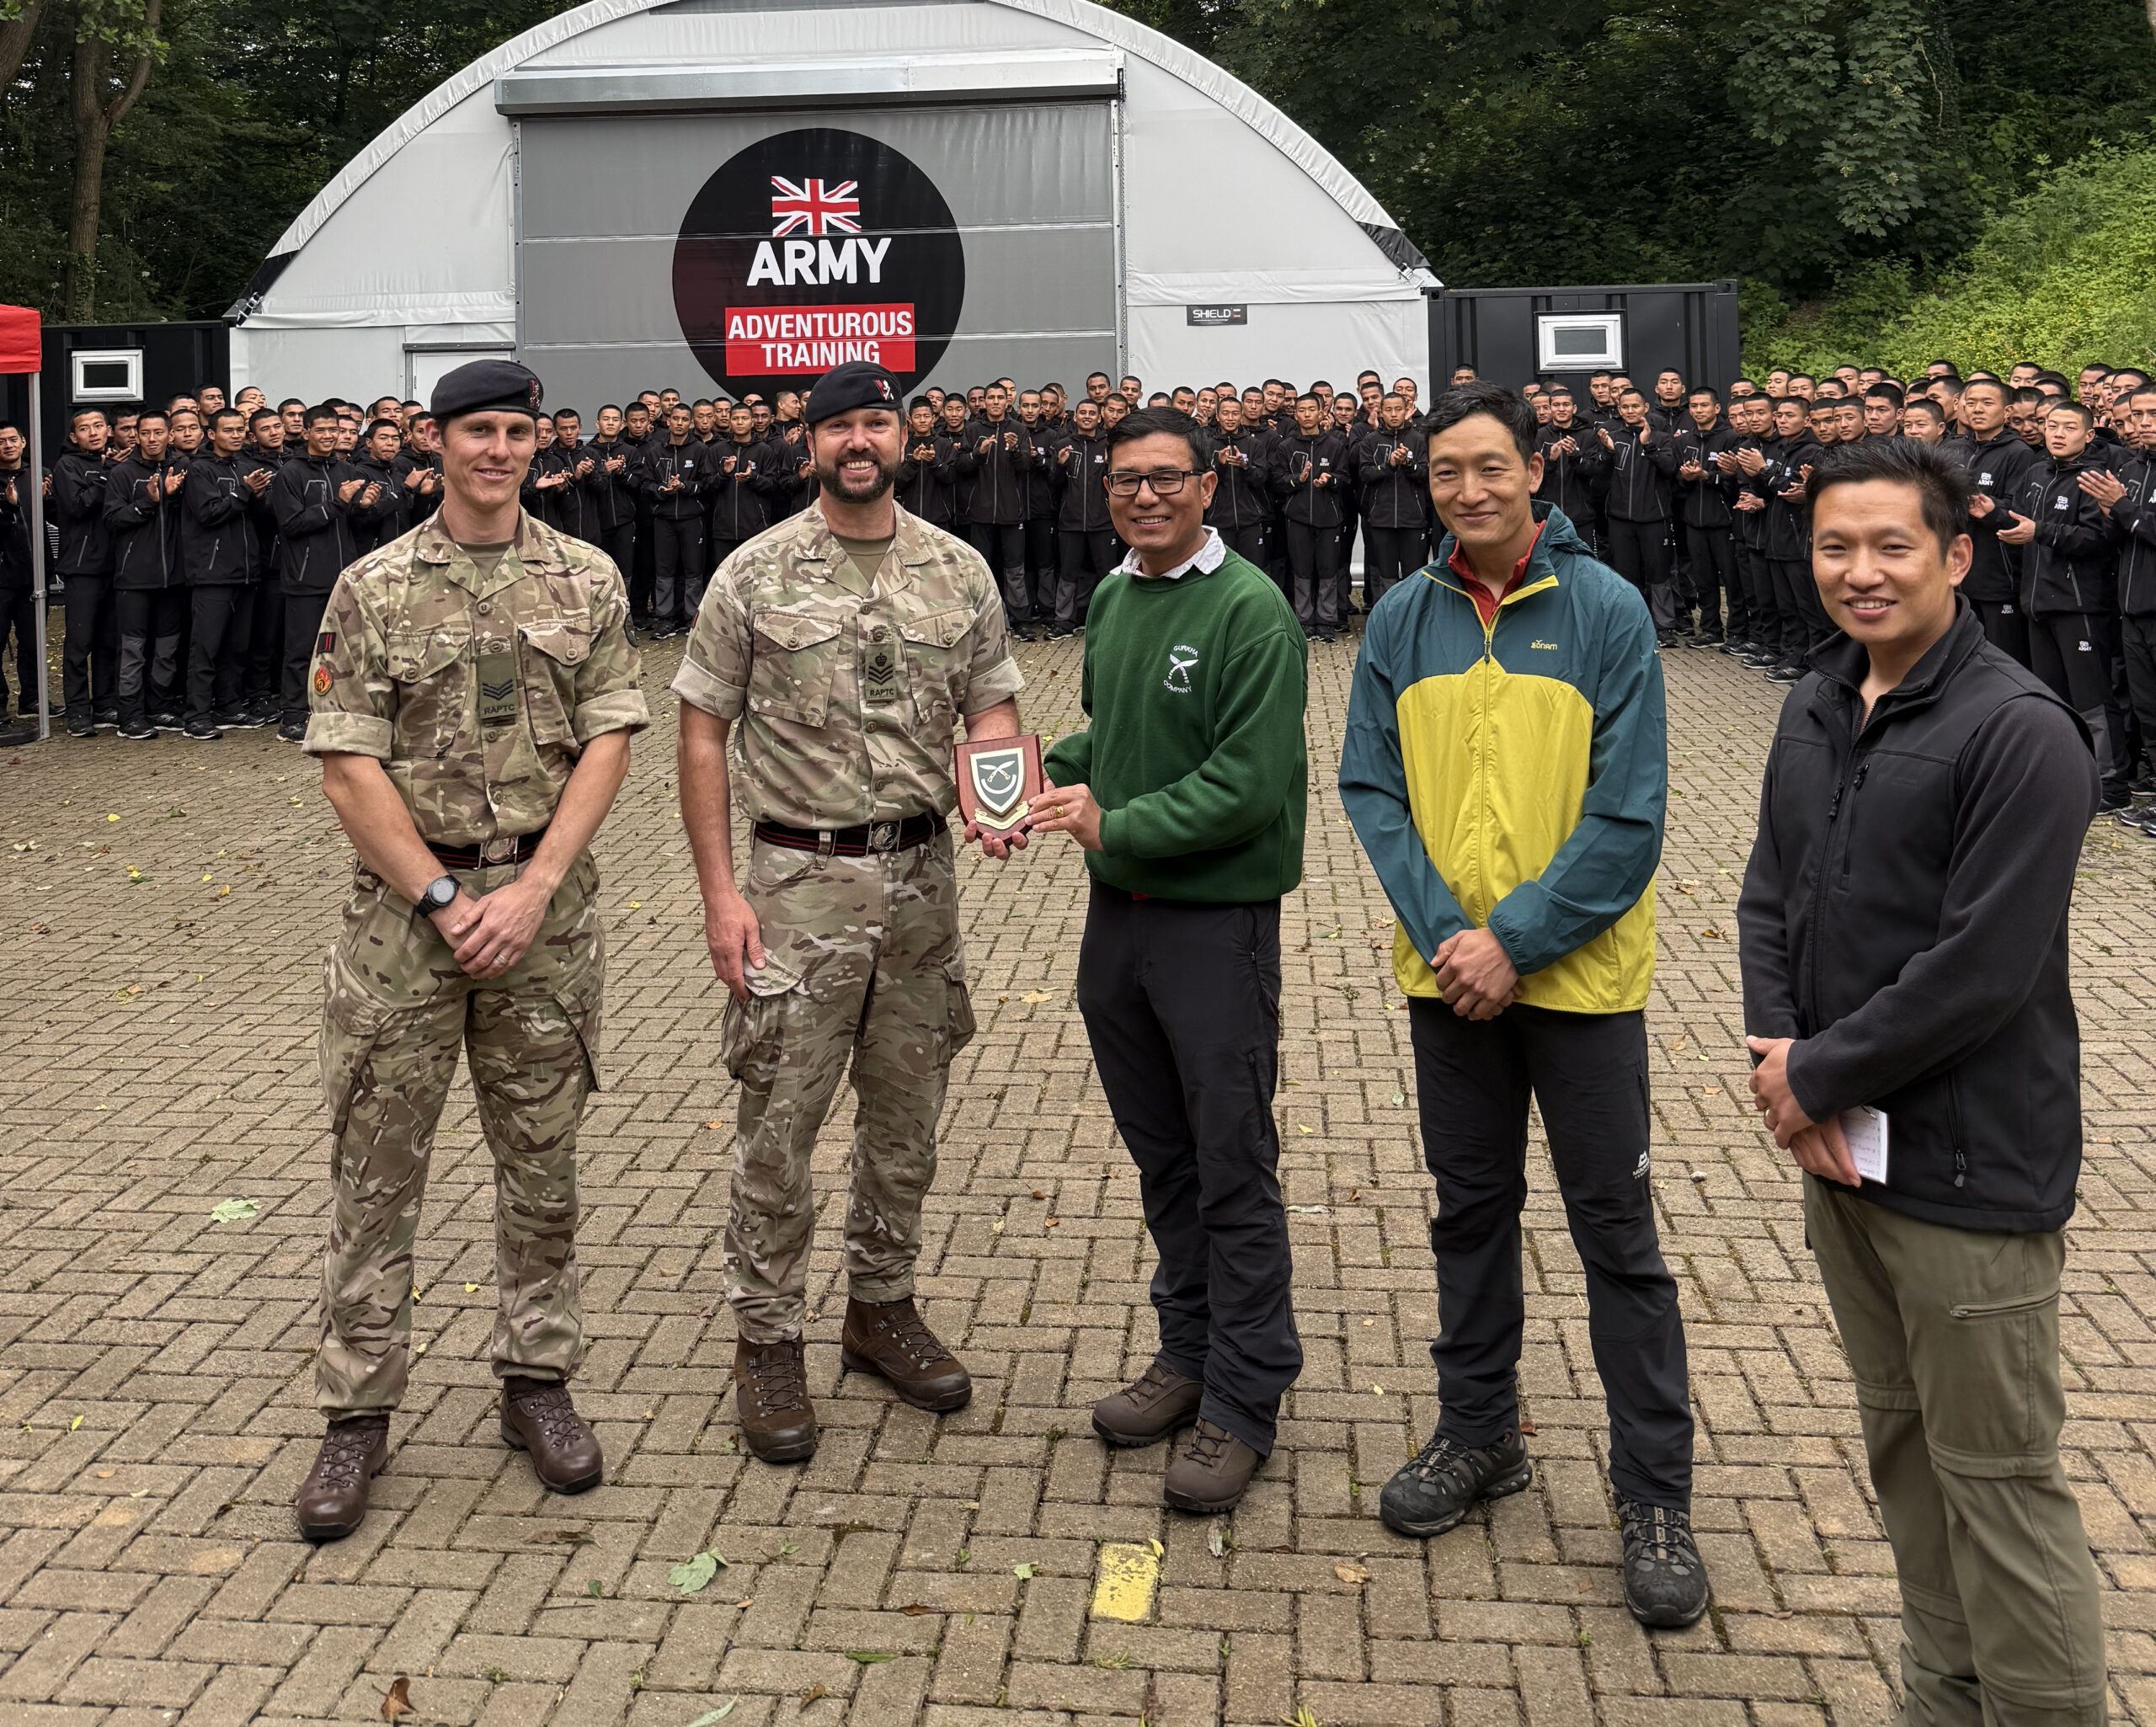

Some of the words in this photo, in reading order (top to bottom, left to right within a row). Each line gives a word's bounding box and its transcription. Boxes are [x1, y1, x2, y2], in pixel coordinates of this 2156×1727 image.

[746, 237, 892, 286] ARMY
[1193, 309, 1231, 318] SHIELD
[728, 312, 913, 339] ADVENTUROUS
[761, 340, 879, 368] TRAINING
[1173, 645, 1198, 658] GURKHA
[1163, 680, 1192, 693] COMPANY
[484, 704, 515, 715] RAPTC
